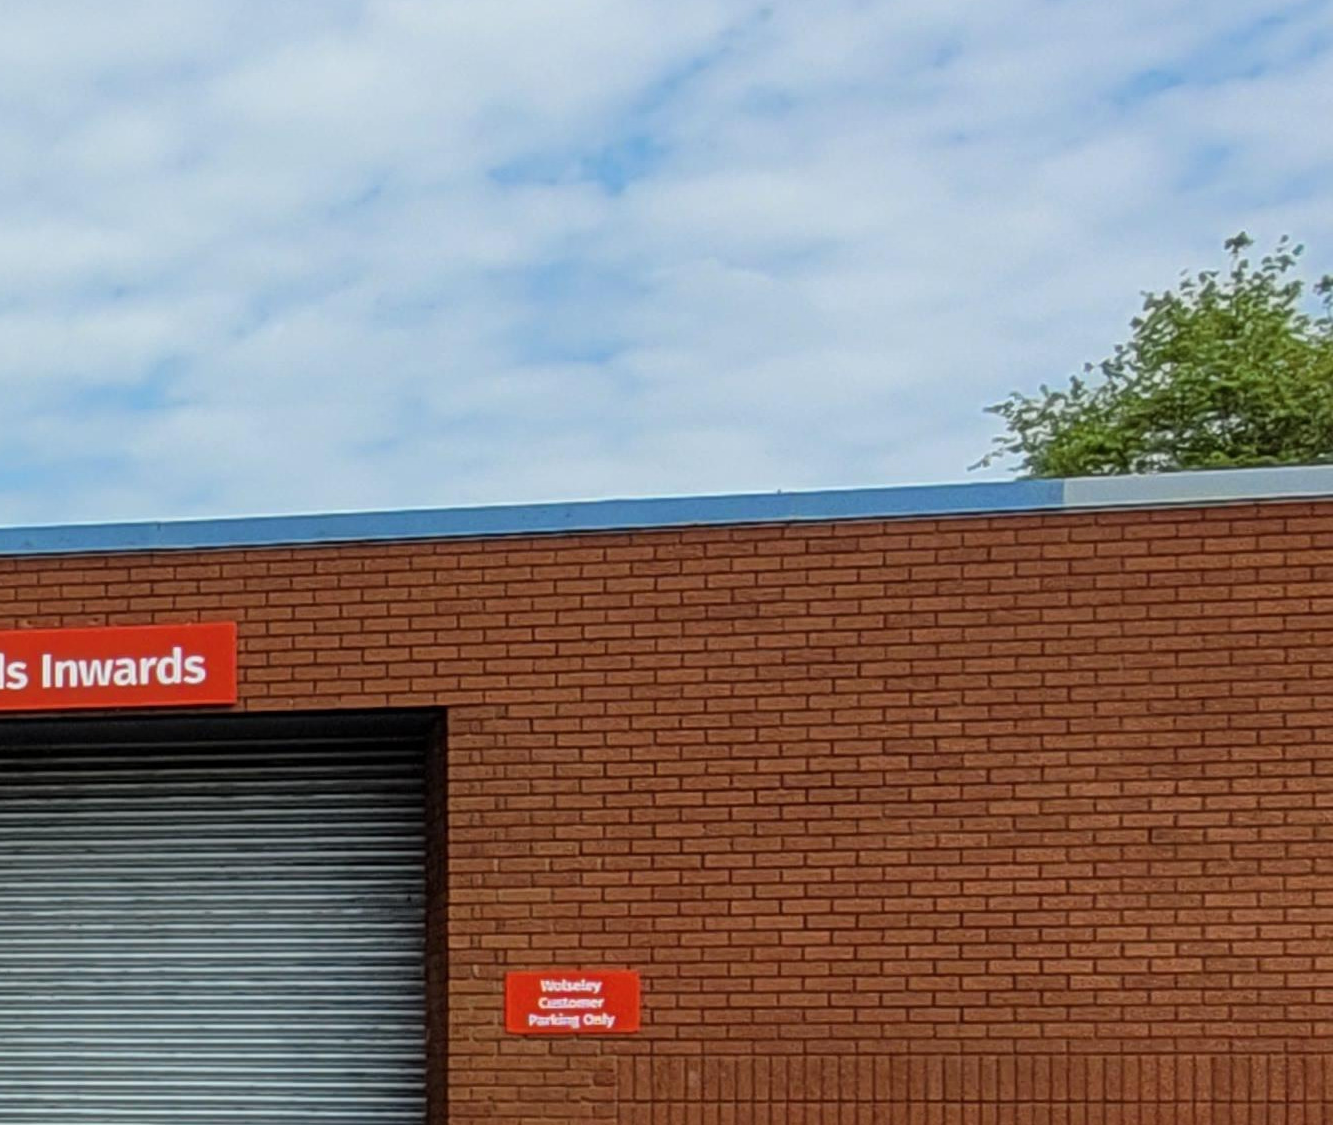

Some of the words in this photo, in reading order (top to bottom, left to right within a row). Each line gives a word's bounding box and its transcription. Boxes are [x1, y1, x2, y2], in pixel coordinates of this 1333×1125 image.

[42, 647, 207, 688] Inwards
[540, 979, 603, 993] Wolseley
[538, 996, 605, 1009] Customer
[528, 1013, 580, 1028] Parking
[583, 1013, 615, 1028] Only
